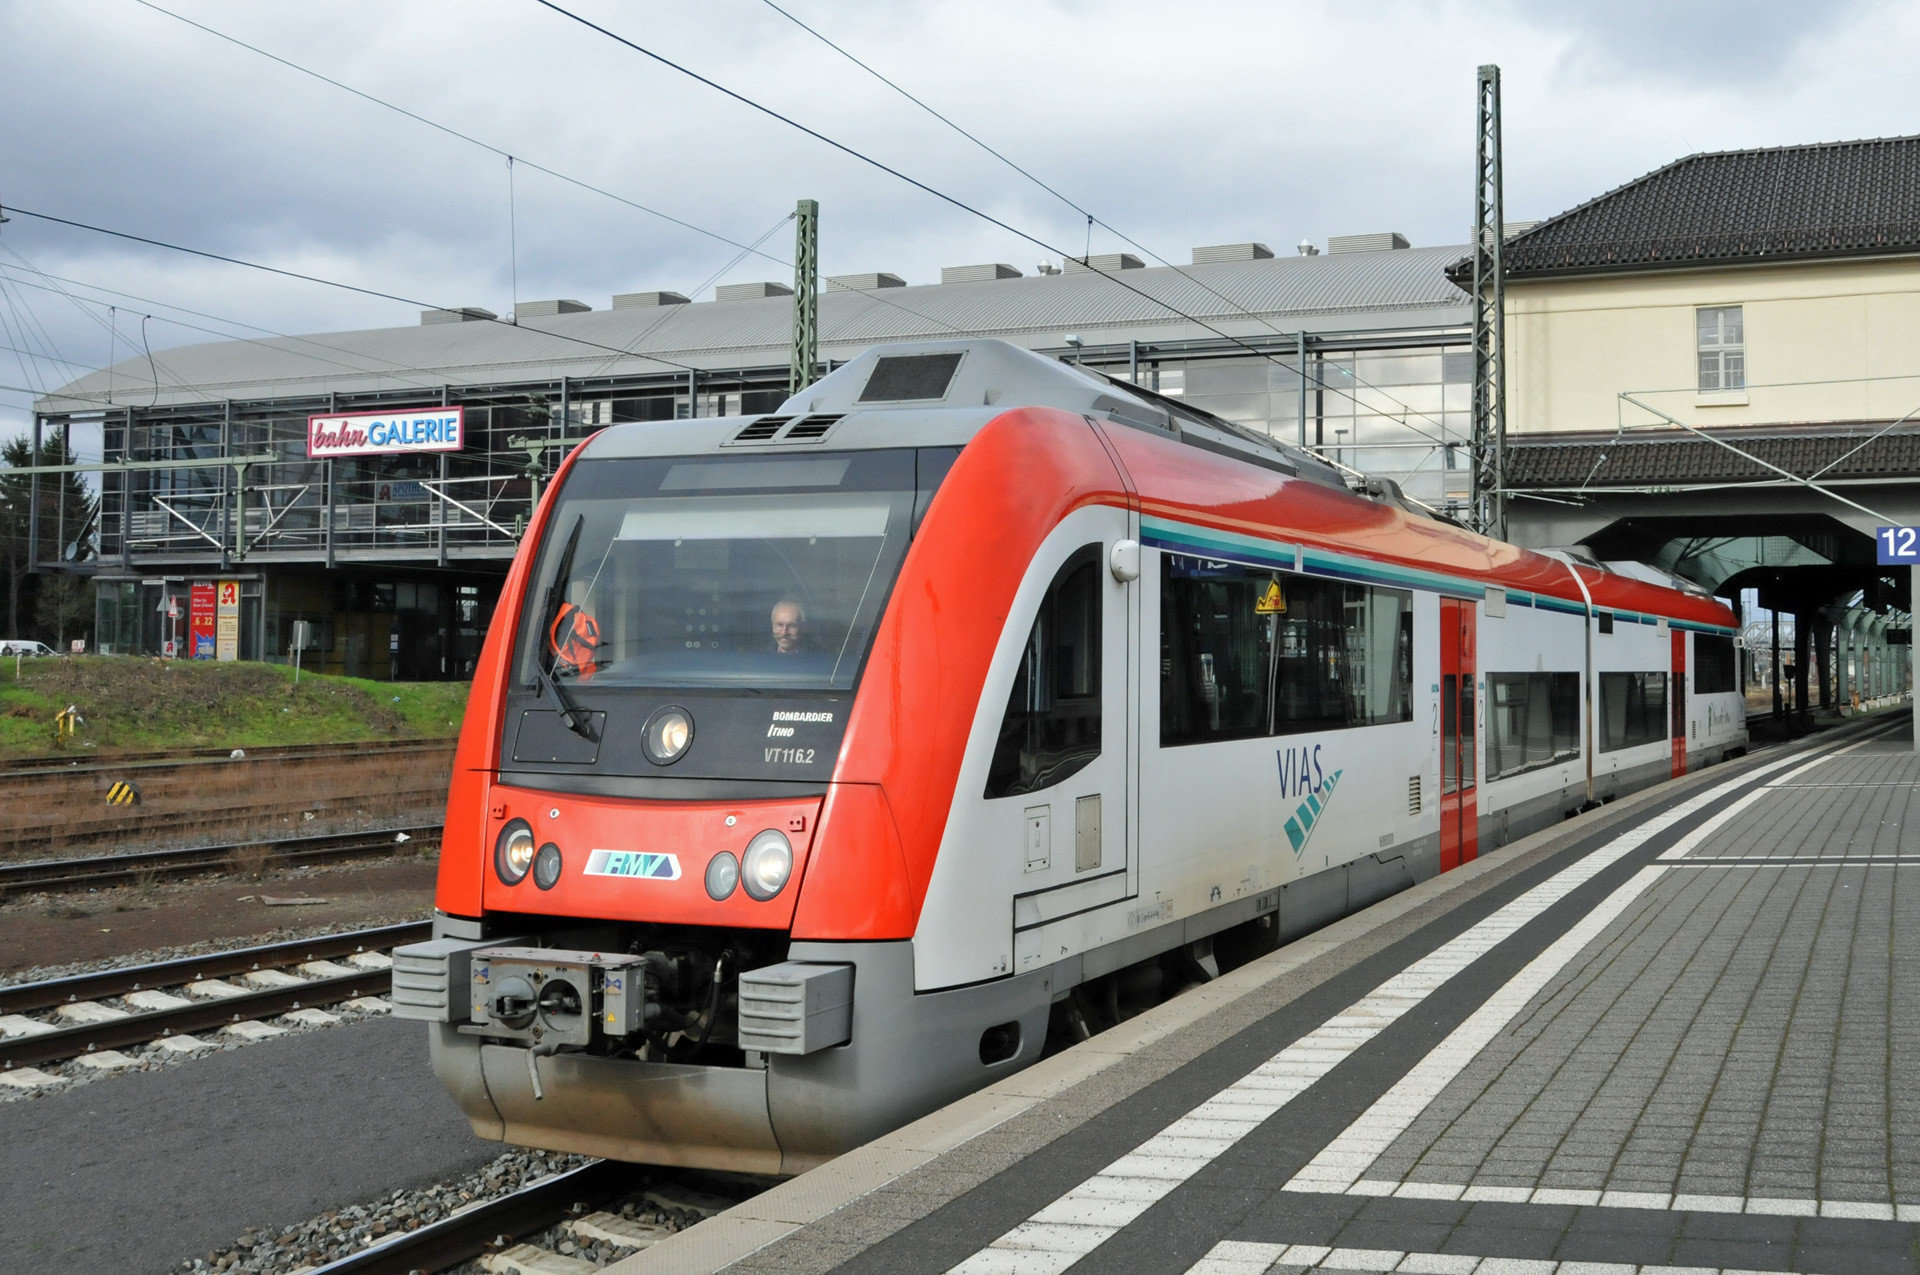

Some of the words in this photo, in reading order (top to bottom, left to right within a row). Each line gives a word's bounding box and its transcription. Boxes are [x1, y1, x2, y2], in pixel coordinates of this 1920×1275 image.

[313, 420, 368, 449] bahn
[367, 417, 457, 446] GALERIE
[1882, 527, 1917, 556] 12
[772, 711, 834, 723] BOMBARDIER
[1276, 743, 1323, 799] VIAS
[603, 852, 667, 877] RMV
